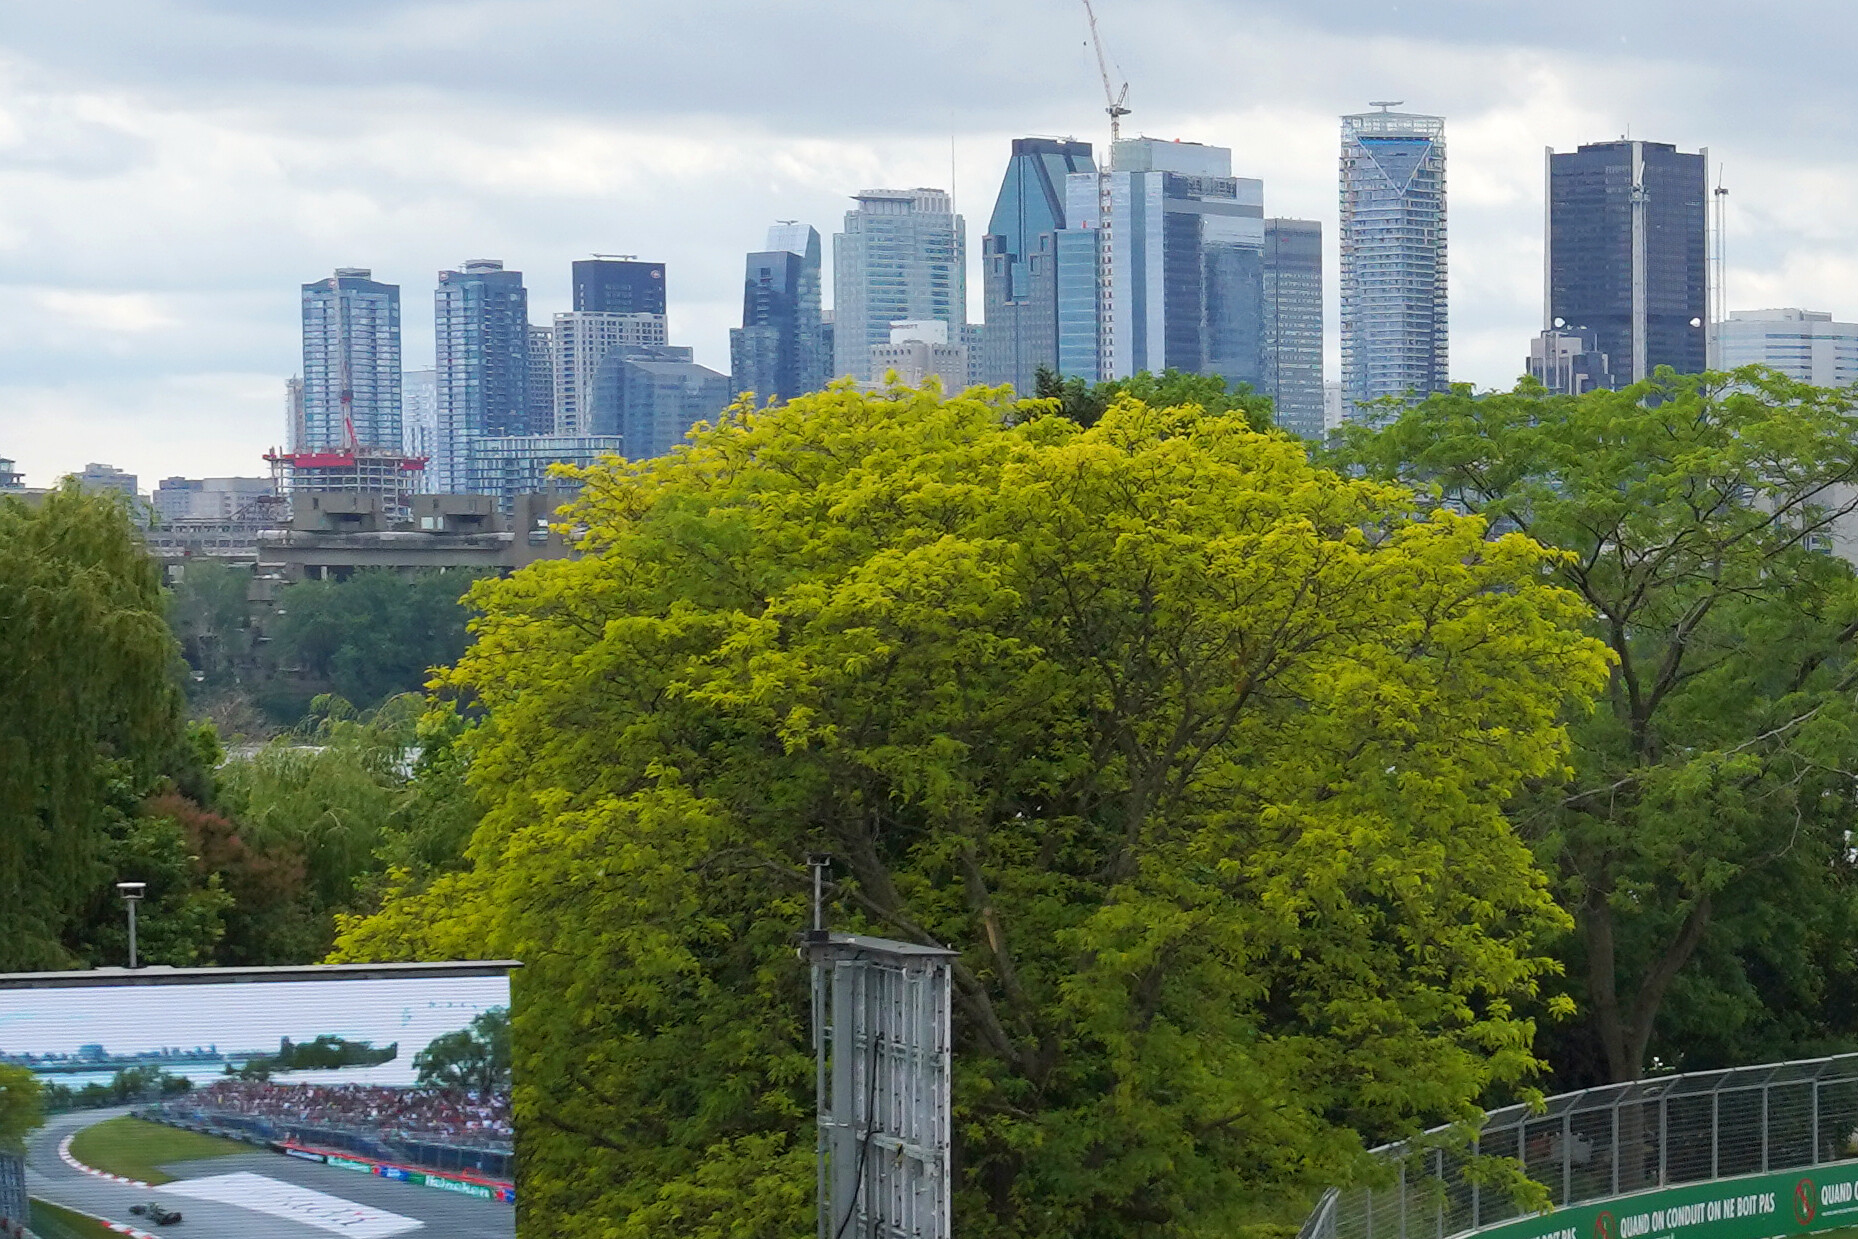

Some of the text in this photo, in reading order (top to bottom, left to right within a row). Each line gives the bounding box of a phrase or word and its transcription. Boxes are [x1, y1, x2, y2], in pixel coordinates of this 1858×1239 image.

[1821, 1182, 1852, 1205] QUAND
[1620, 1193, 1775, 1238] QUAND ON CONDUIT ON NE BOIT PAS
